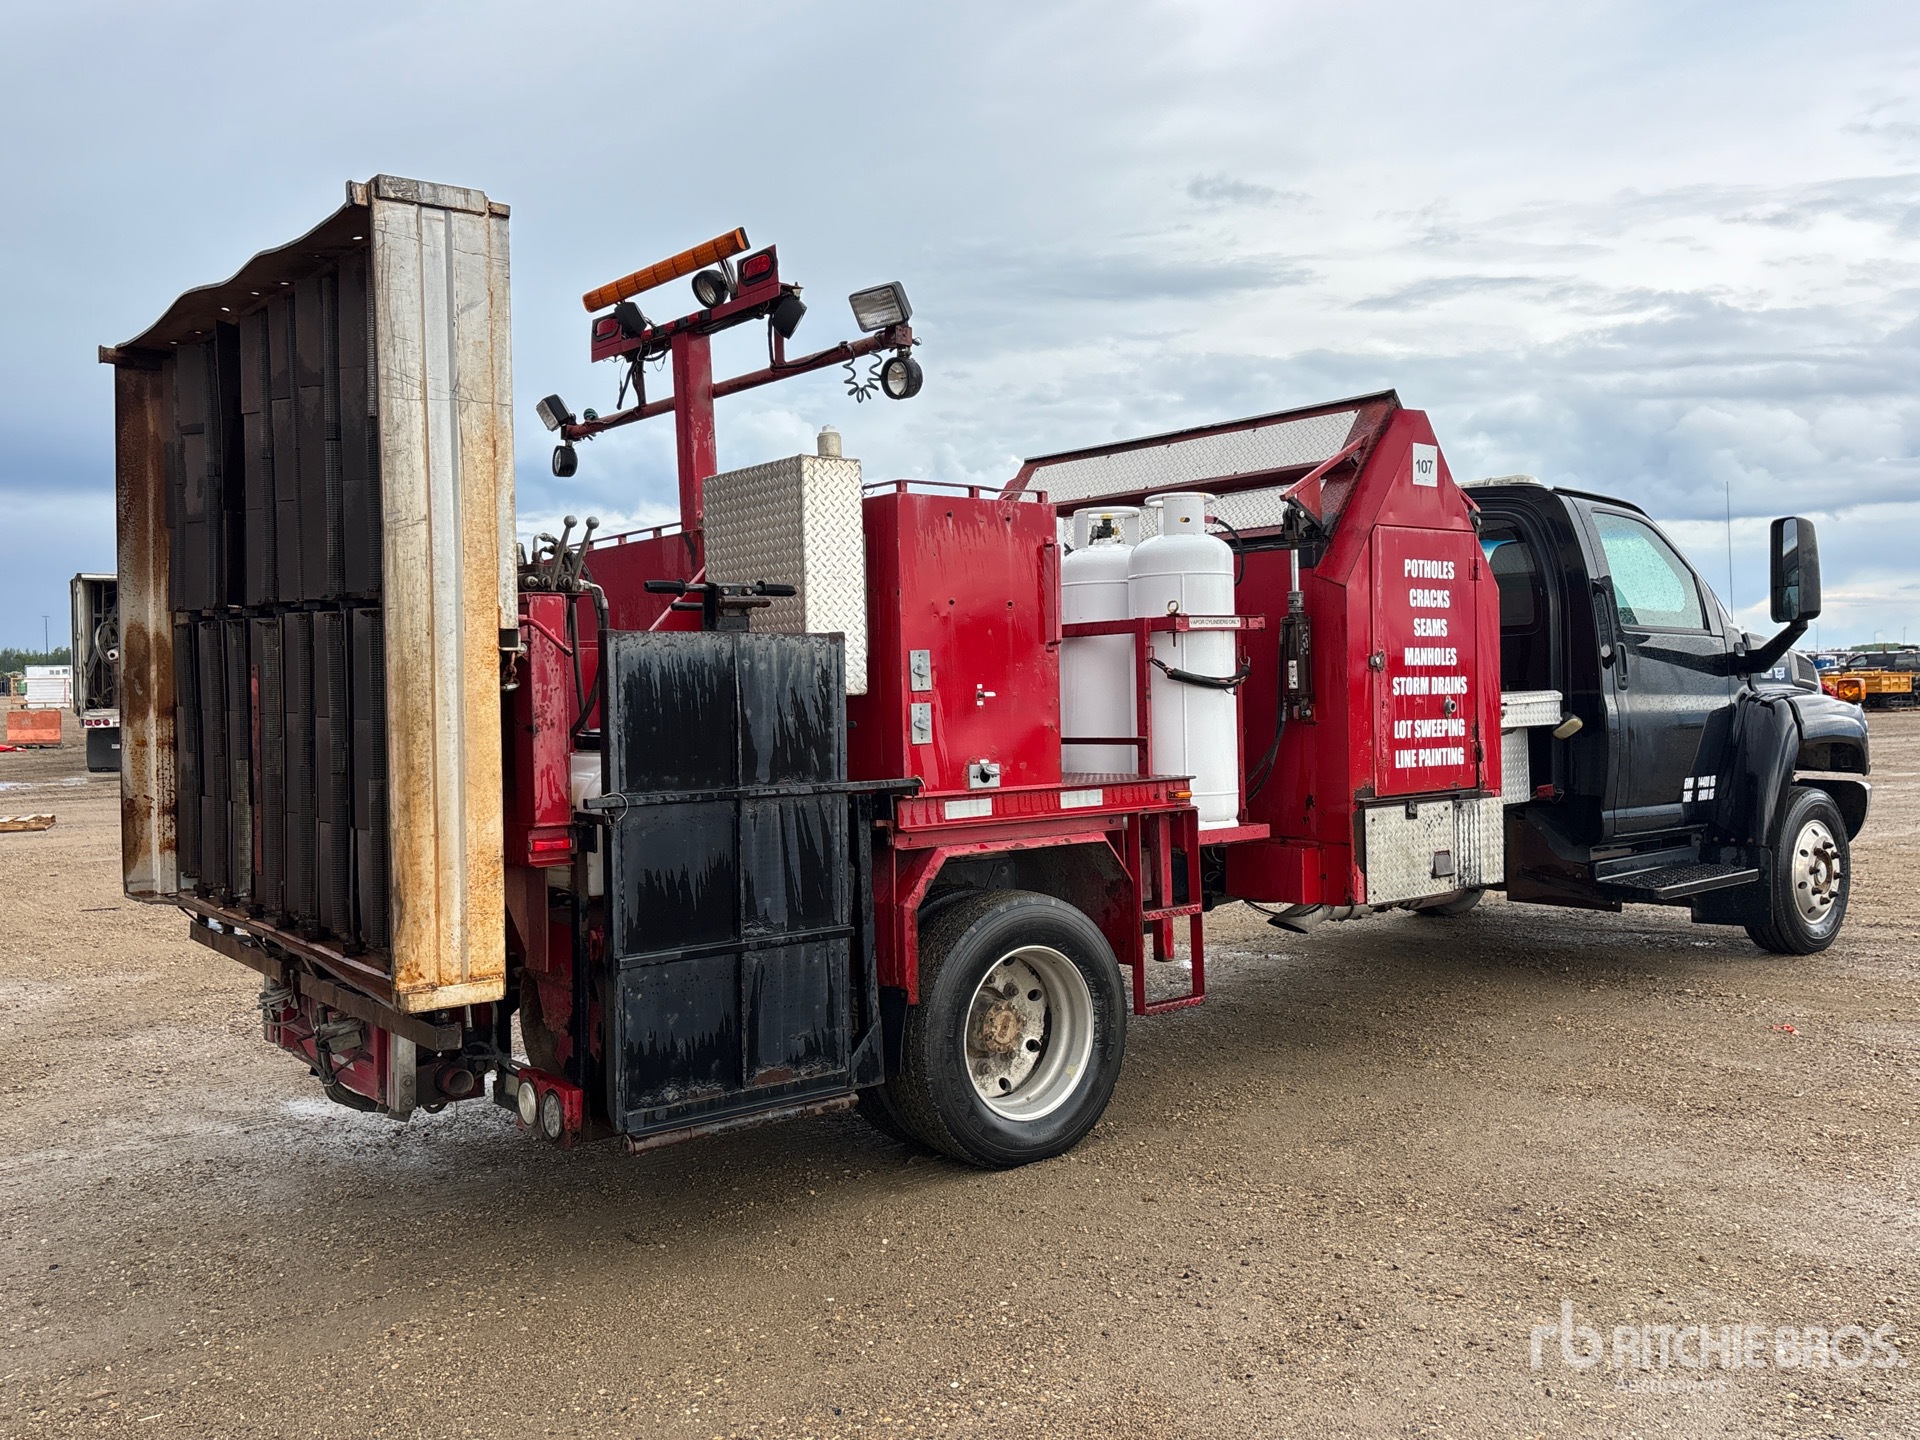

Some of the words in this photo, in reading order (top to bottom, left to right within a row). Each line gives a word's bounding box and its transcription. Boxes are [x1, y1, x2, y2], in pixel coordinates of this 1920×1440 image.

[1415, 458, 1433, 475] 107
[1404, 559, 1455, 579] POTHOLES
[1409, 588, 1450, 608] CRACKS
[1413, 617, 1448, 637] SEAMS
[1404, 647, 1457, 666] MANHOLES
[1392, 676, 1429, 696] STORM
[1431, 676, 1468, 695] DRAINS
[1394, 720, 1413, 739] LOT
[1414, 718, 1465, 738] SWEEPING
[1395, 750, 1417, 769] LINE
[1418, 747, 1465, 767] PAINTING
